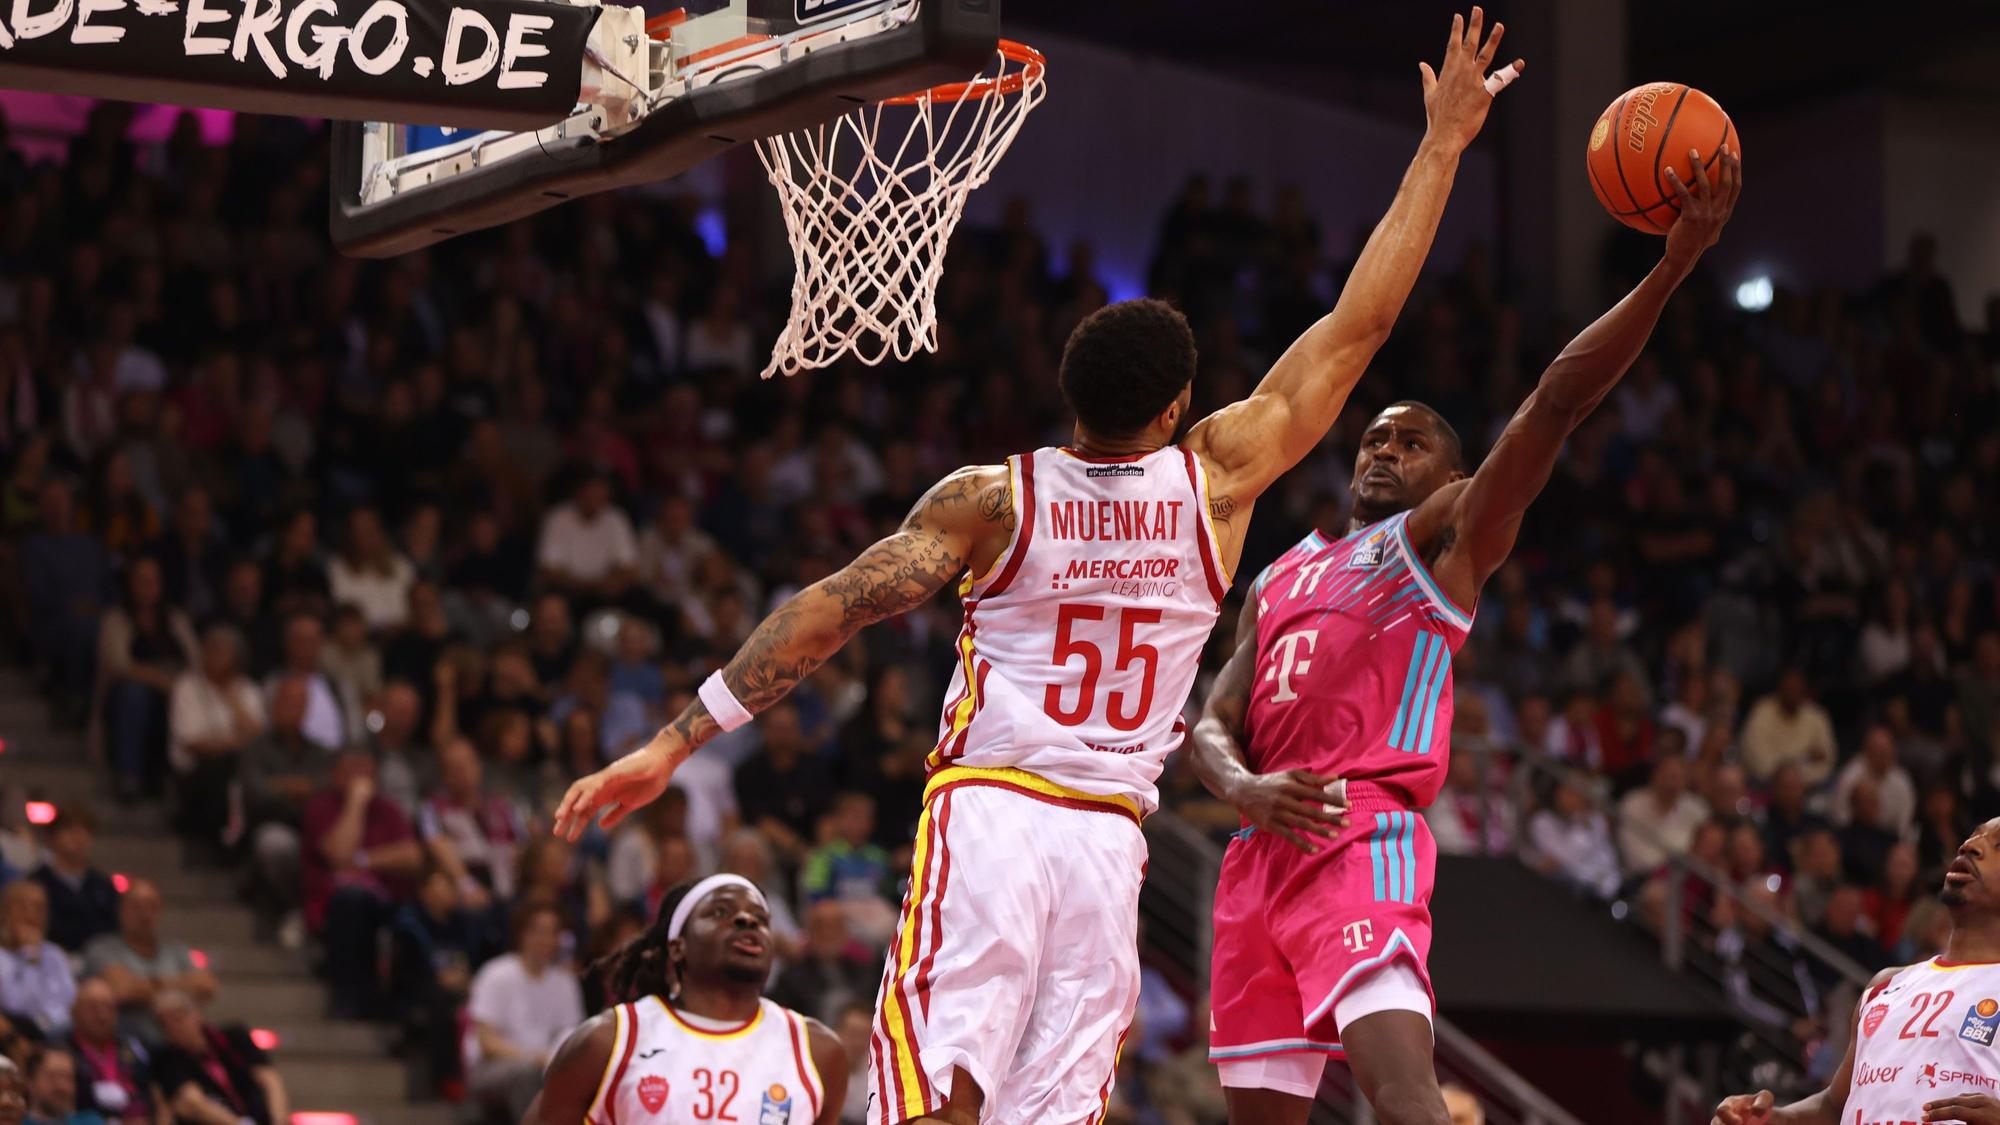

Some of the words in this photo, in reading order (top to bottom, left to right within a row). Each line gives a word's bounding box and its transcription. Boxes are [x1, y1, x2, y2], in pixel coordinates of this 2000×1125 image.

[0, 0, 554, 89] DE-ERGO.DE
[1629, 87, 1678, 153] Baden
[1088, 468, 1143, 477] #PureEmotion
[1050, 500, 1183, 542] MUENKAT
[1065, 559, 1180, 580] MERCATOR
[1352, 550, 1379, 565] BBL
[1110, 580, 1177, 599] LEASING
[1043, 603, 1164, 732] 55
[1898, 991, 1955, 1041] 22
[1961, 1026, 1989, 1043] BBL
[692, 1067, 740, 1122] 32
